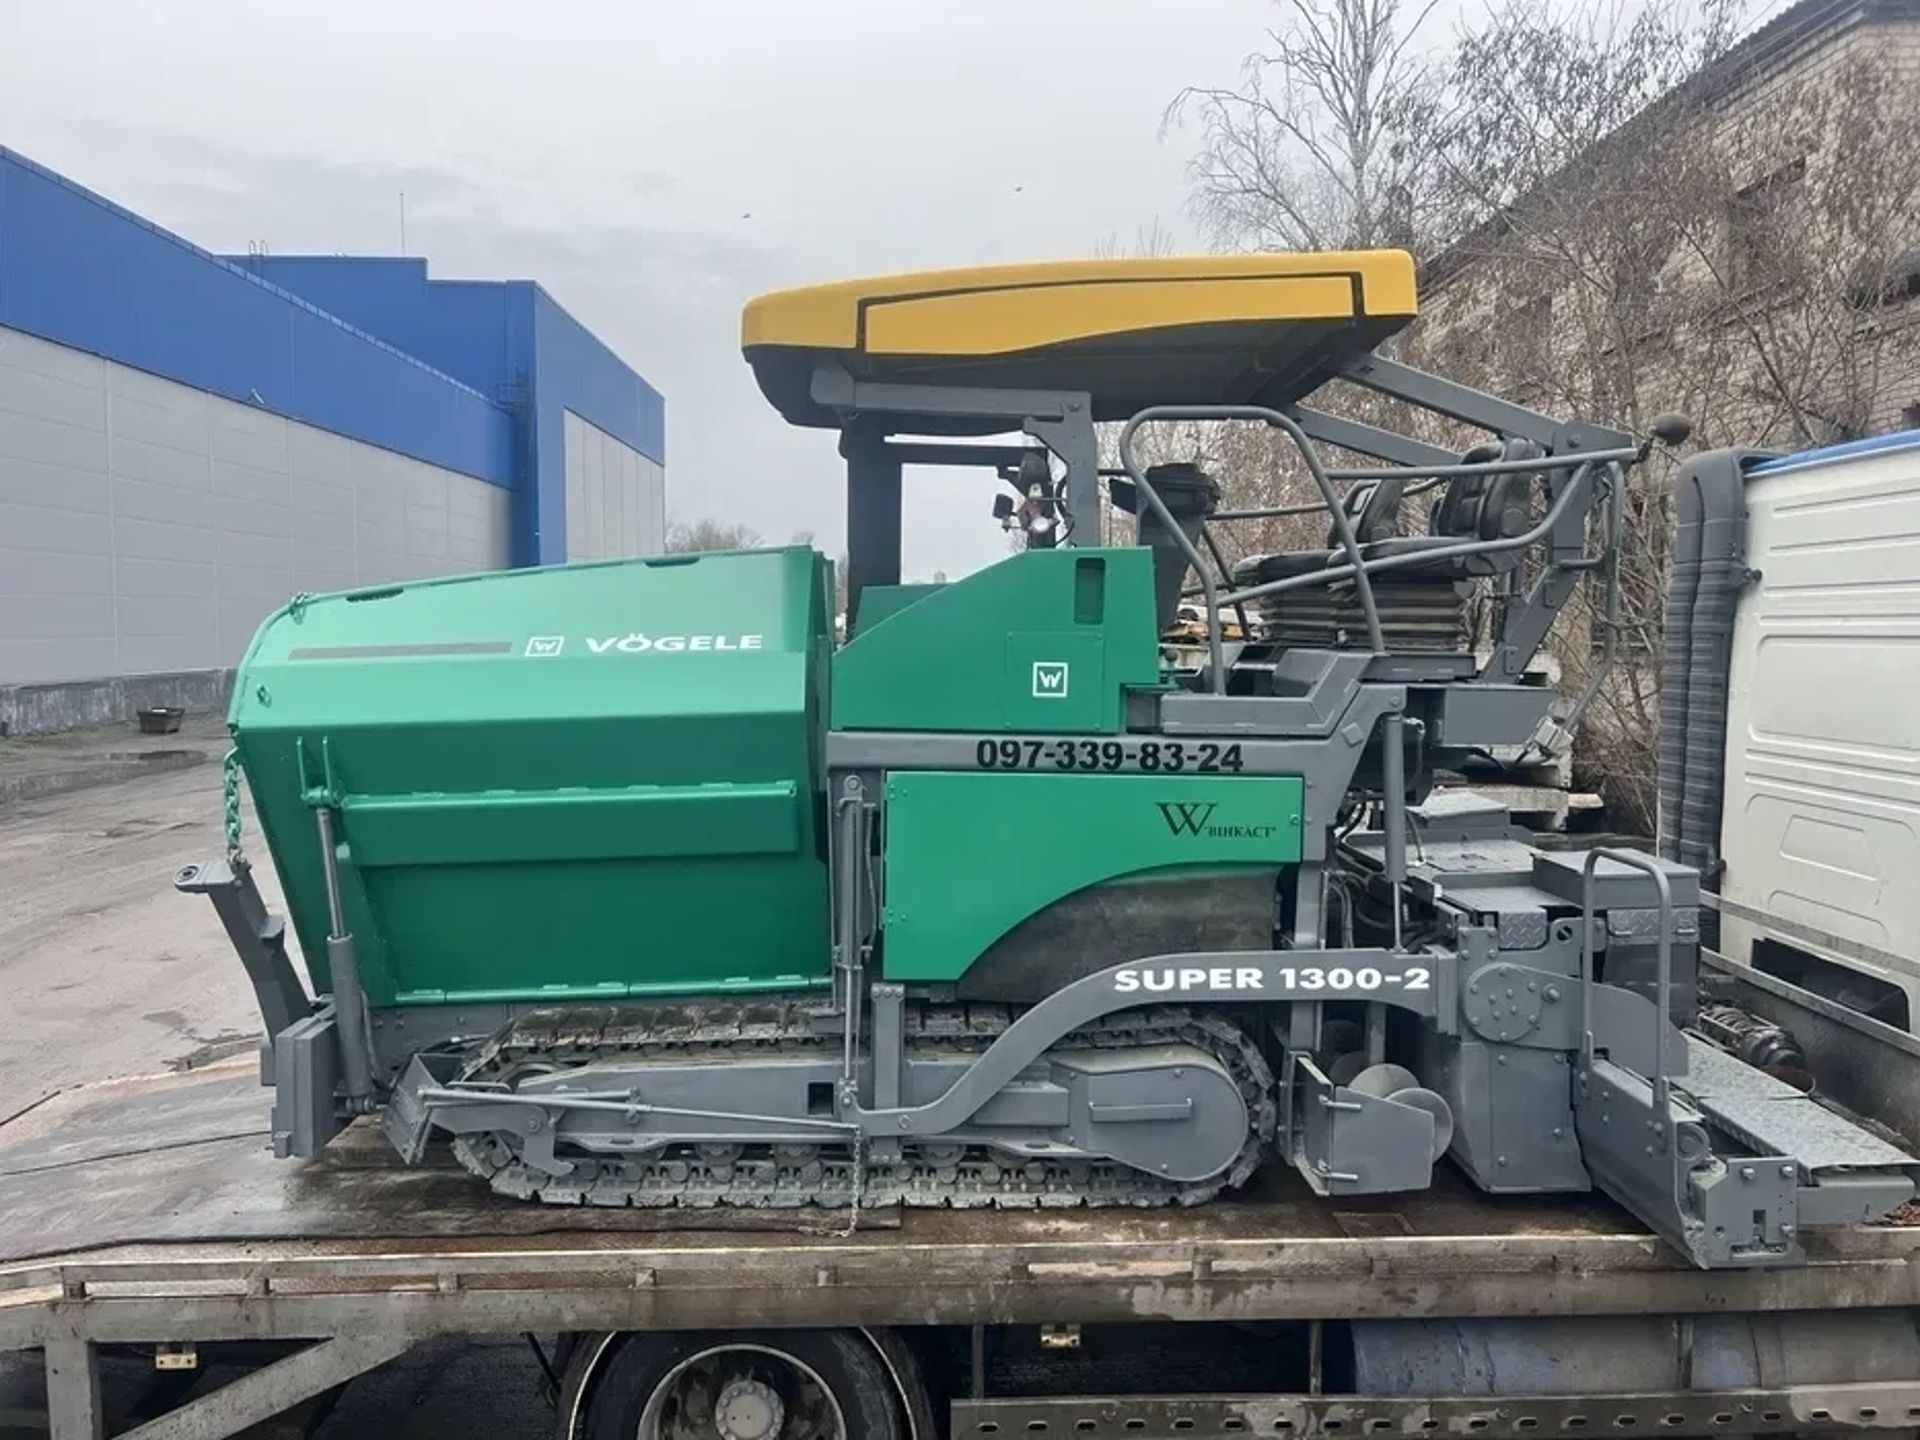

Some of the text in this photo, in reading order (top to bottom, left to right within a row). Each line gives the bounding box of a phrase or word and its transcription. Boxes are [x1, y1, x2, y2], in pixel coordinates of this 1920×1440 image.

[585, 633, 763, 653] VÖGELE
[976, 739, 1244, 772] 097-339-83-24
[1153, 801, 1218, 837] W
[1114, 967, 1430, 992] SUPER 1300-2
